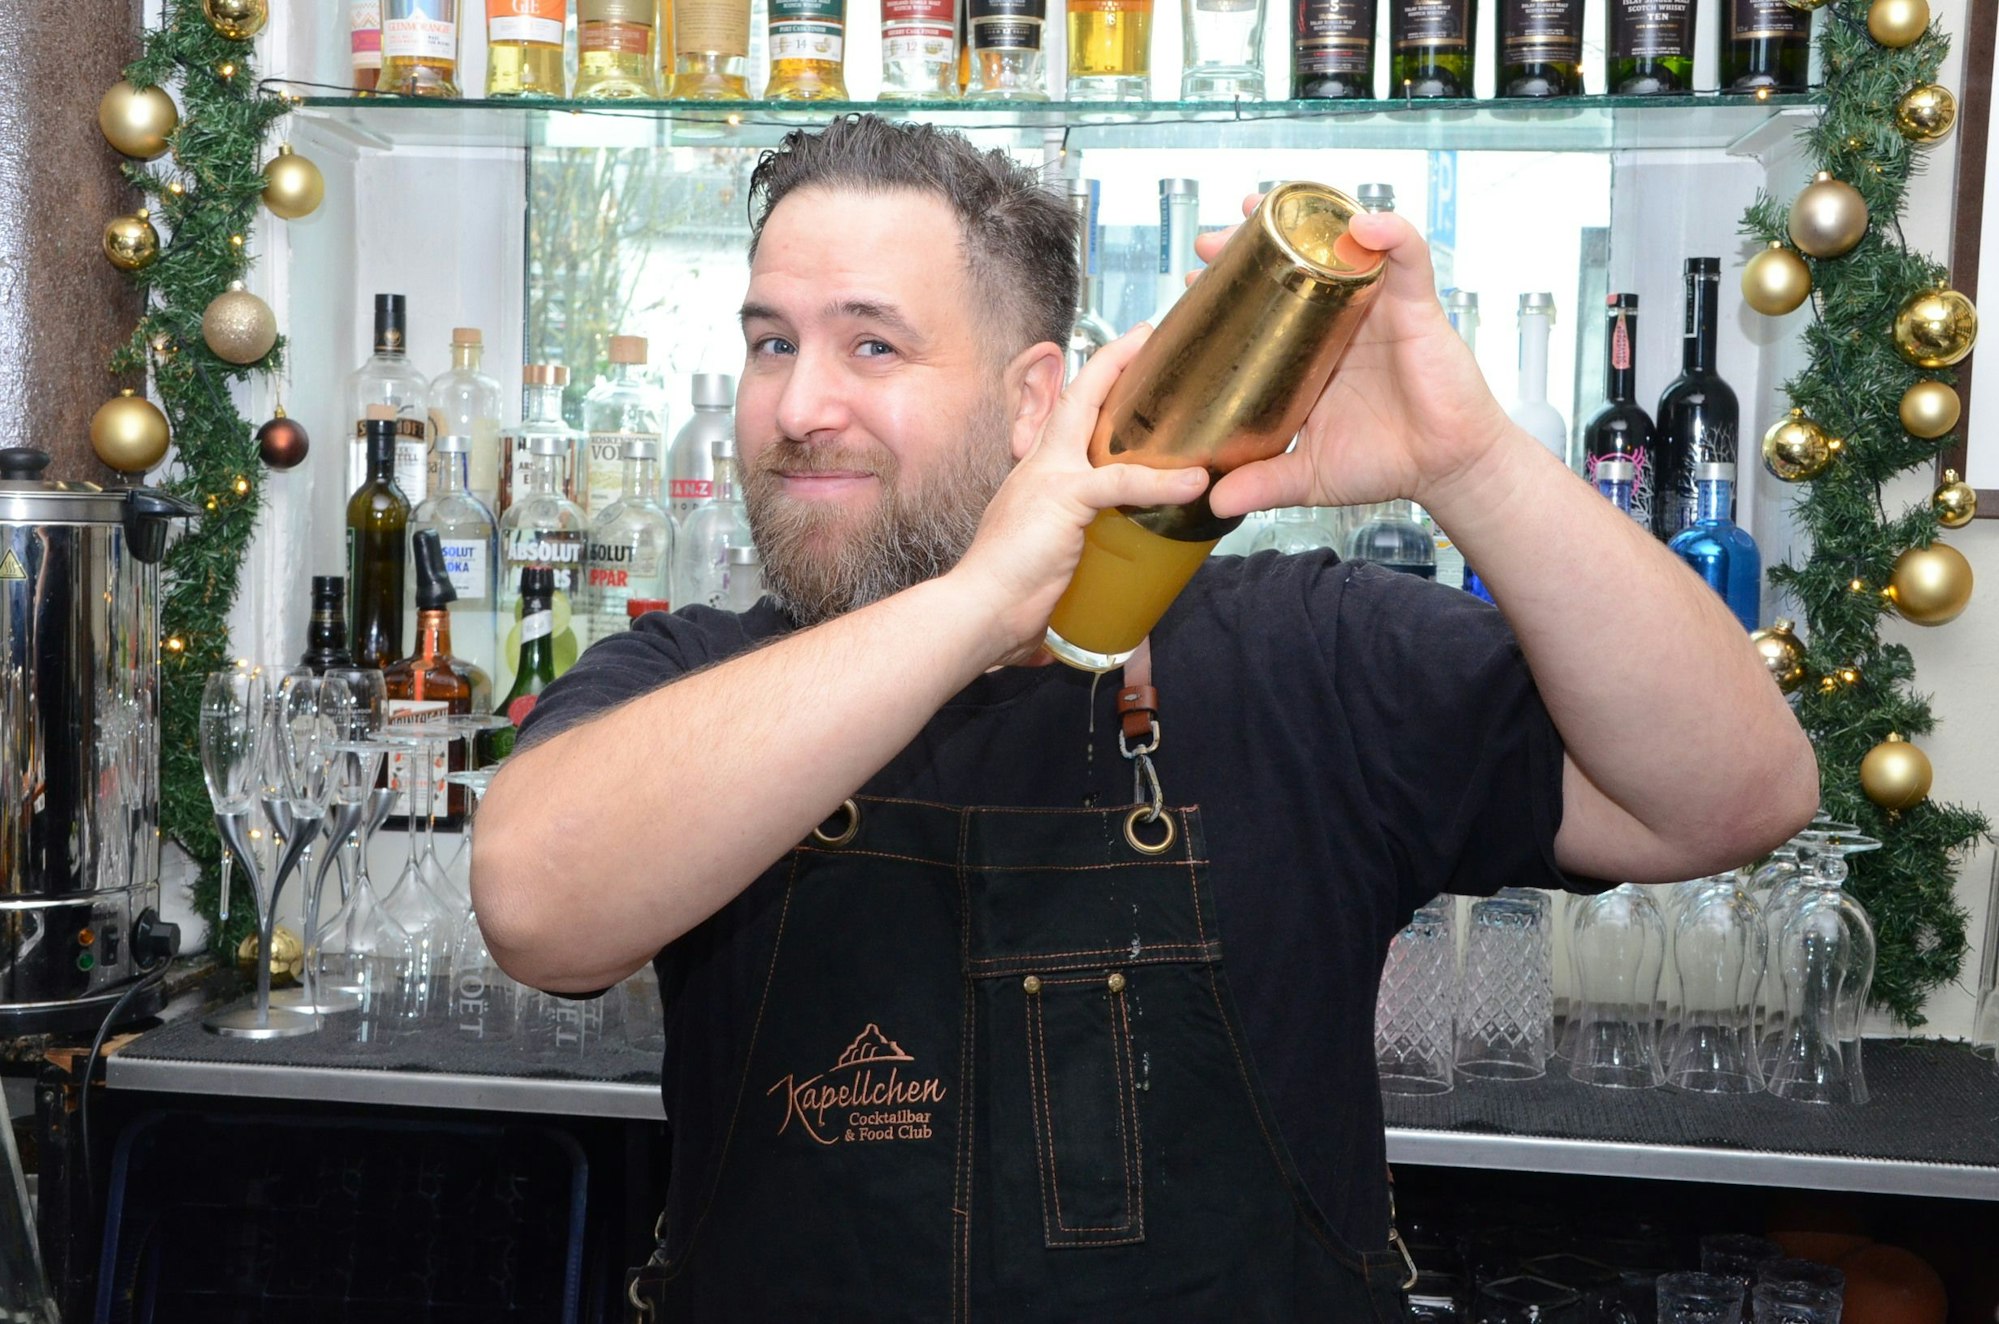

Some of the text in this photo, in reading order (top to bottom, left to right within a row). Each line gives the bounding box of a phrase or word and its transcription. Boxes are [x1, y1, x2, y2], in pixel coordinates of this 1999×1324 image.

[1627, 5, 1657, 13] SCOTCH
[1646, 13, 1670, 21] TEN
[388, 22, 450, 33] GLENMRANGIE
[442, 547, 475, 558] SOLUT
[507, 542, 582, 562] ABSOLUT
[588, 569, 628, 587] PPAR
[767, 1067, 946, 1144] Kapellchen
[849, 1109, 932, 1126] Cocktailbar
[844, 1125, 933, 1142] & Food Club
